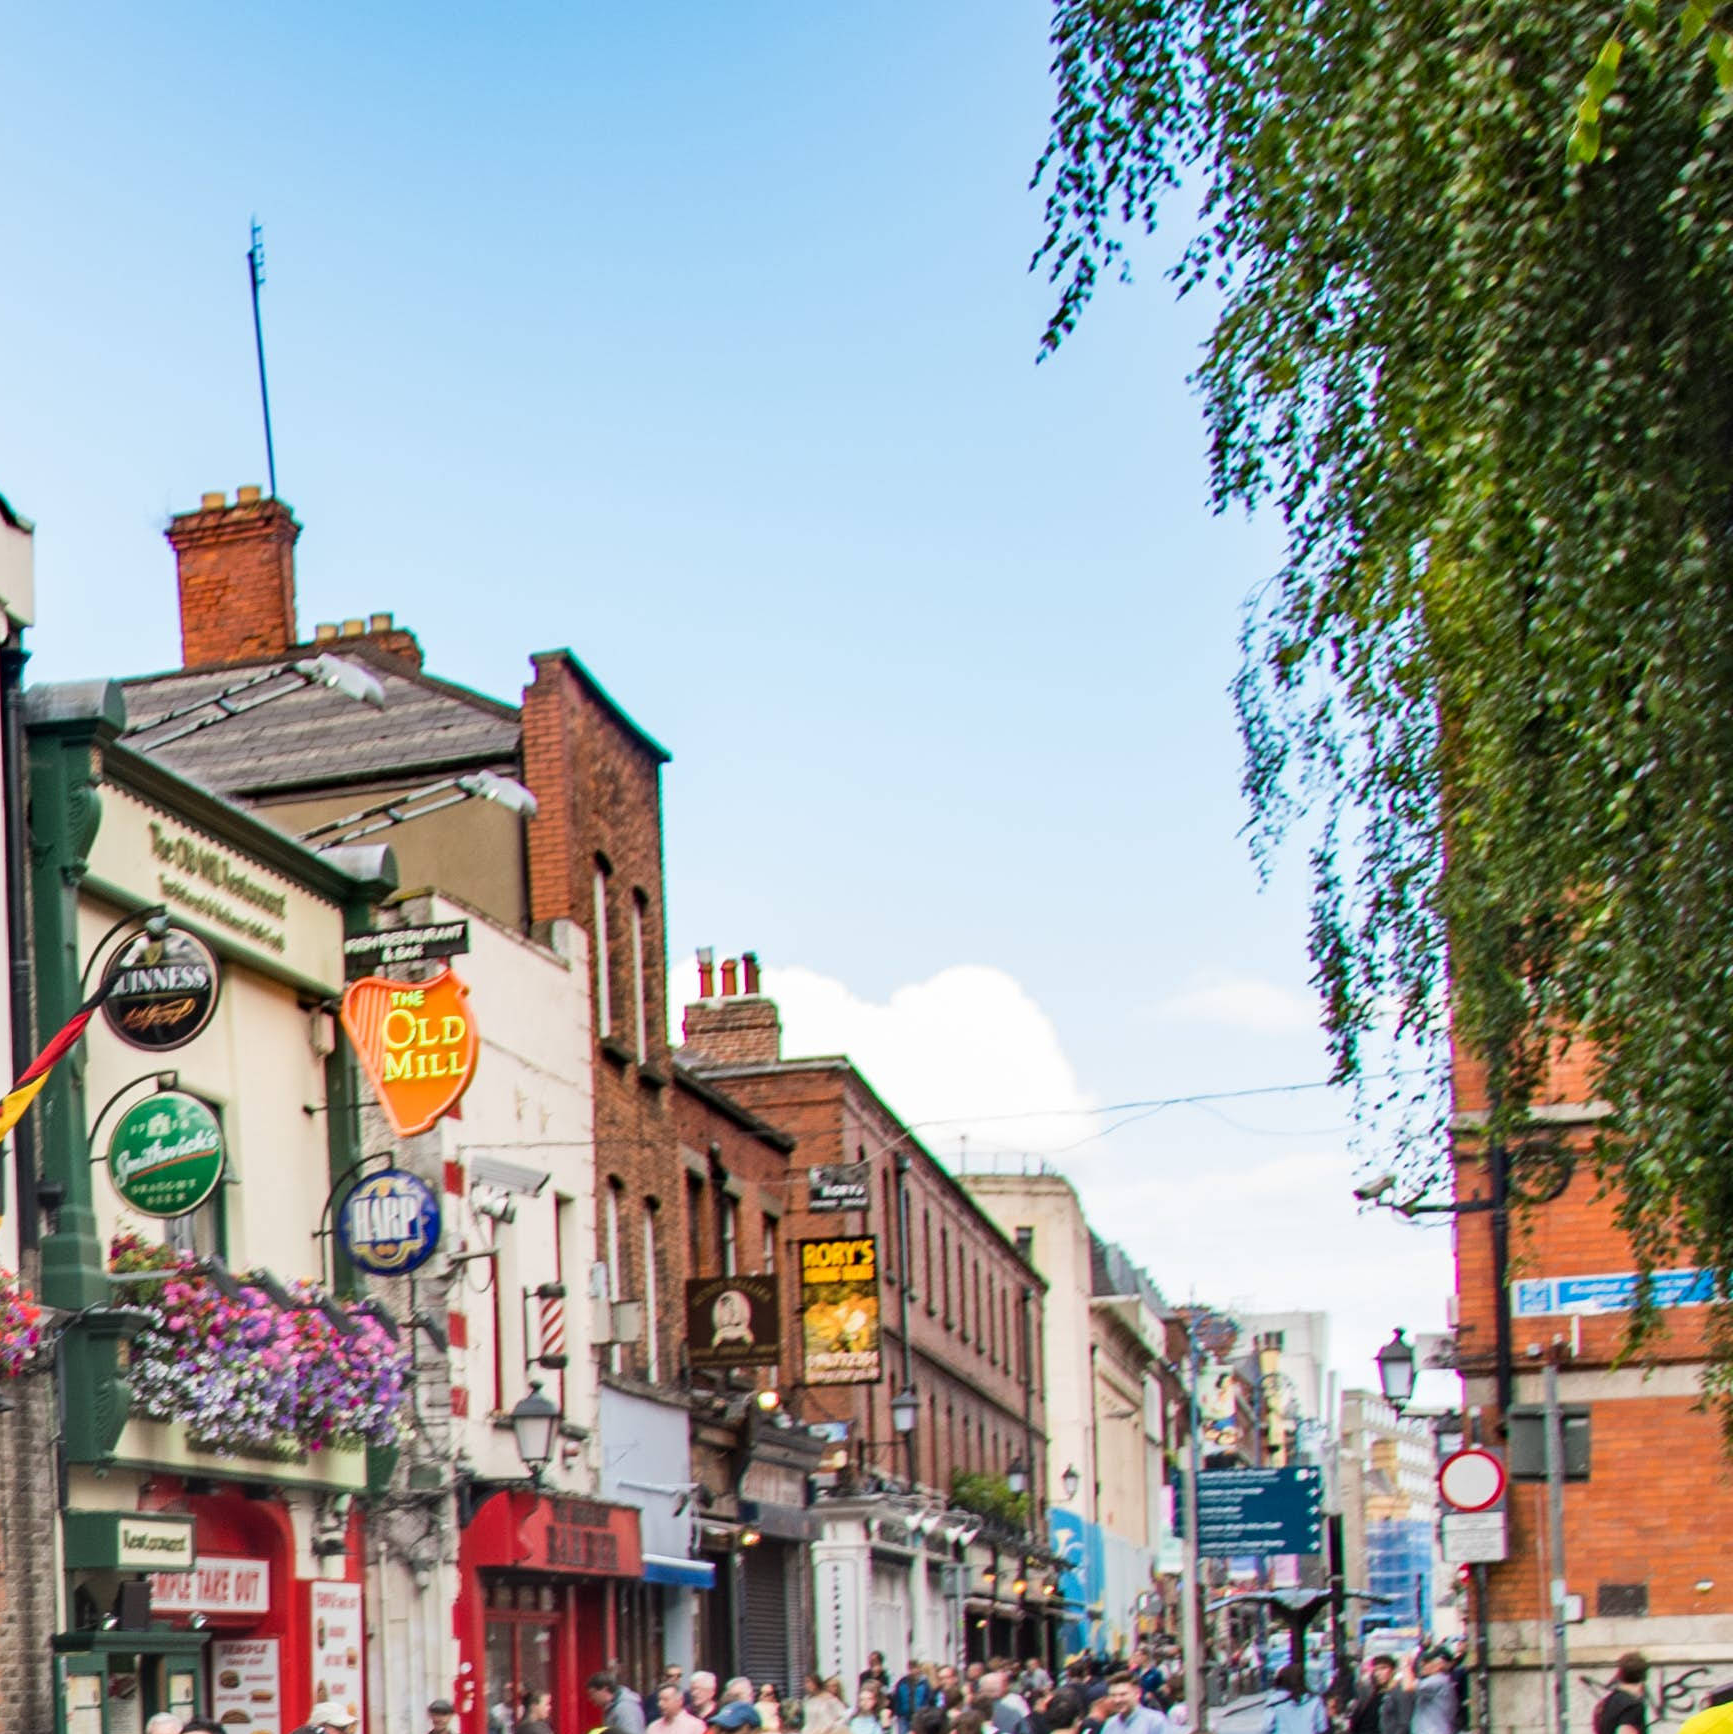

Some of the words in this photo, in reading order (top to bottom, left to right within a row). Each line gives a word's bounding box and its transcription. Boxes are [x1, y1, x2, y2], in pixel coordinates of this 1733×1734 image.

[109, 965, 208, 998] UINNESS
[390, 989, 425, 1008] THE
[354, 1196, 420, 1241] HARP
[803, 1240, 875, 1268] RORY'S
[197, 1569, 230, 1601] TAKE
[235, 1571, 260, 1602] OUT
